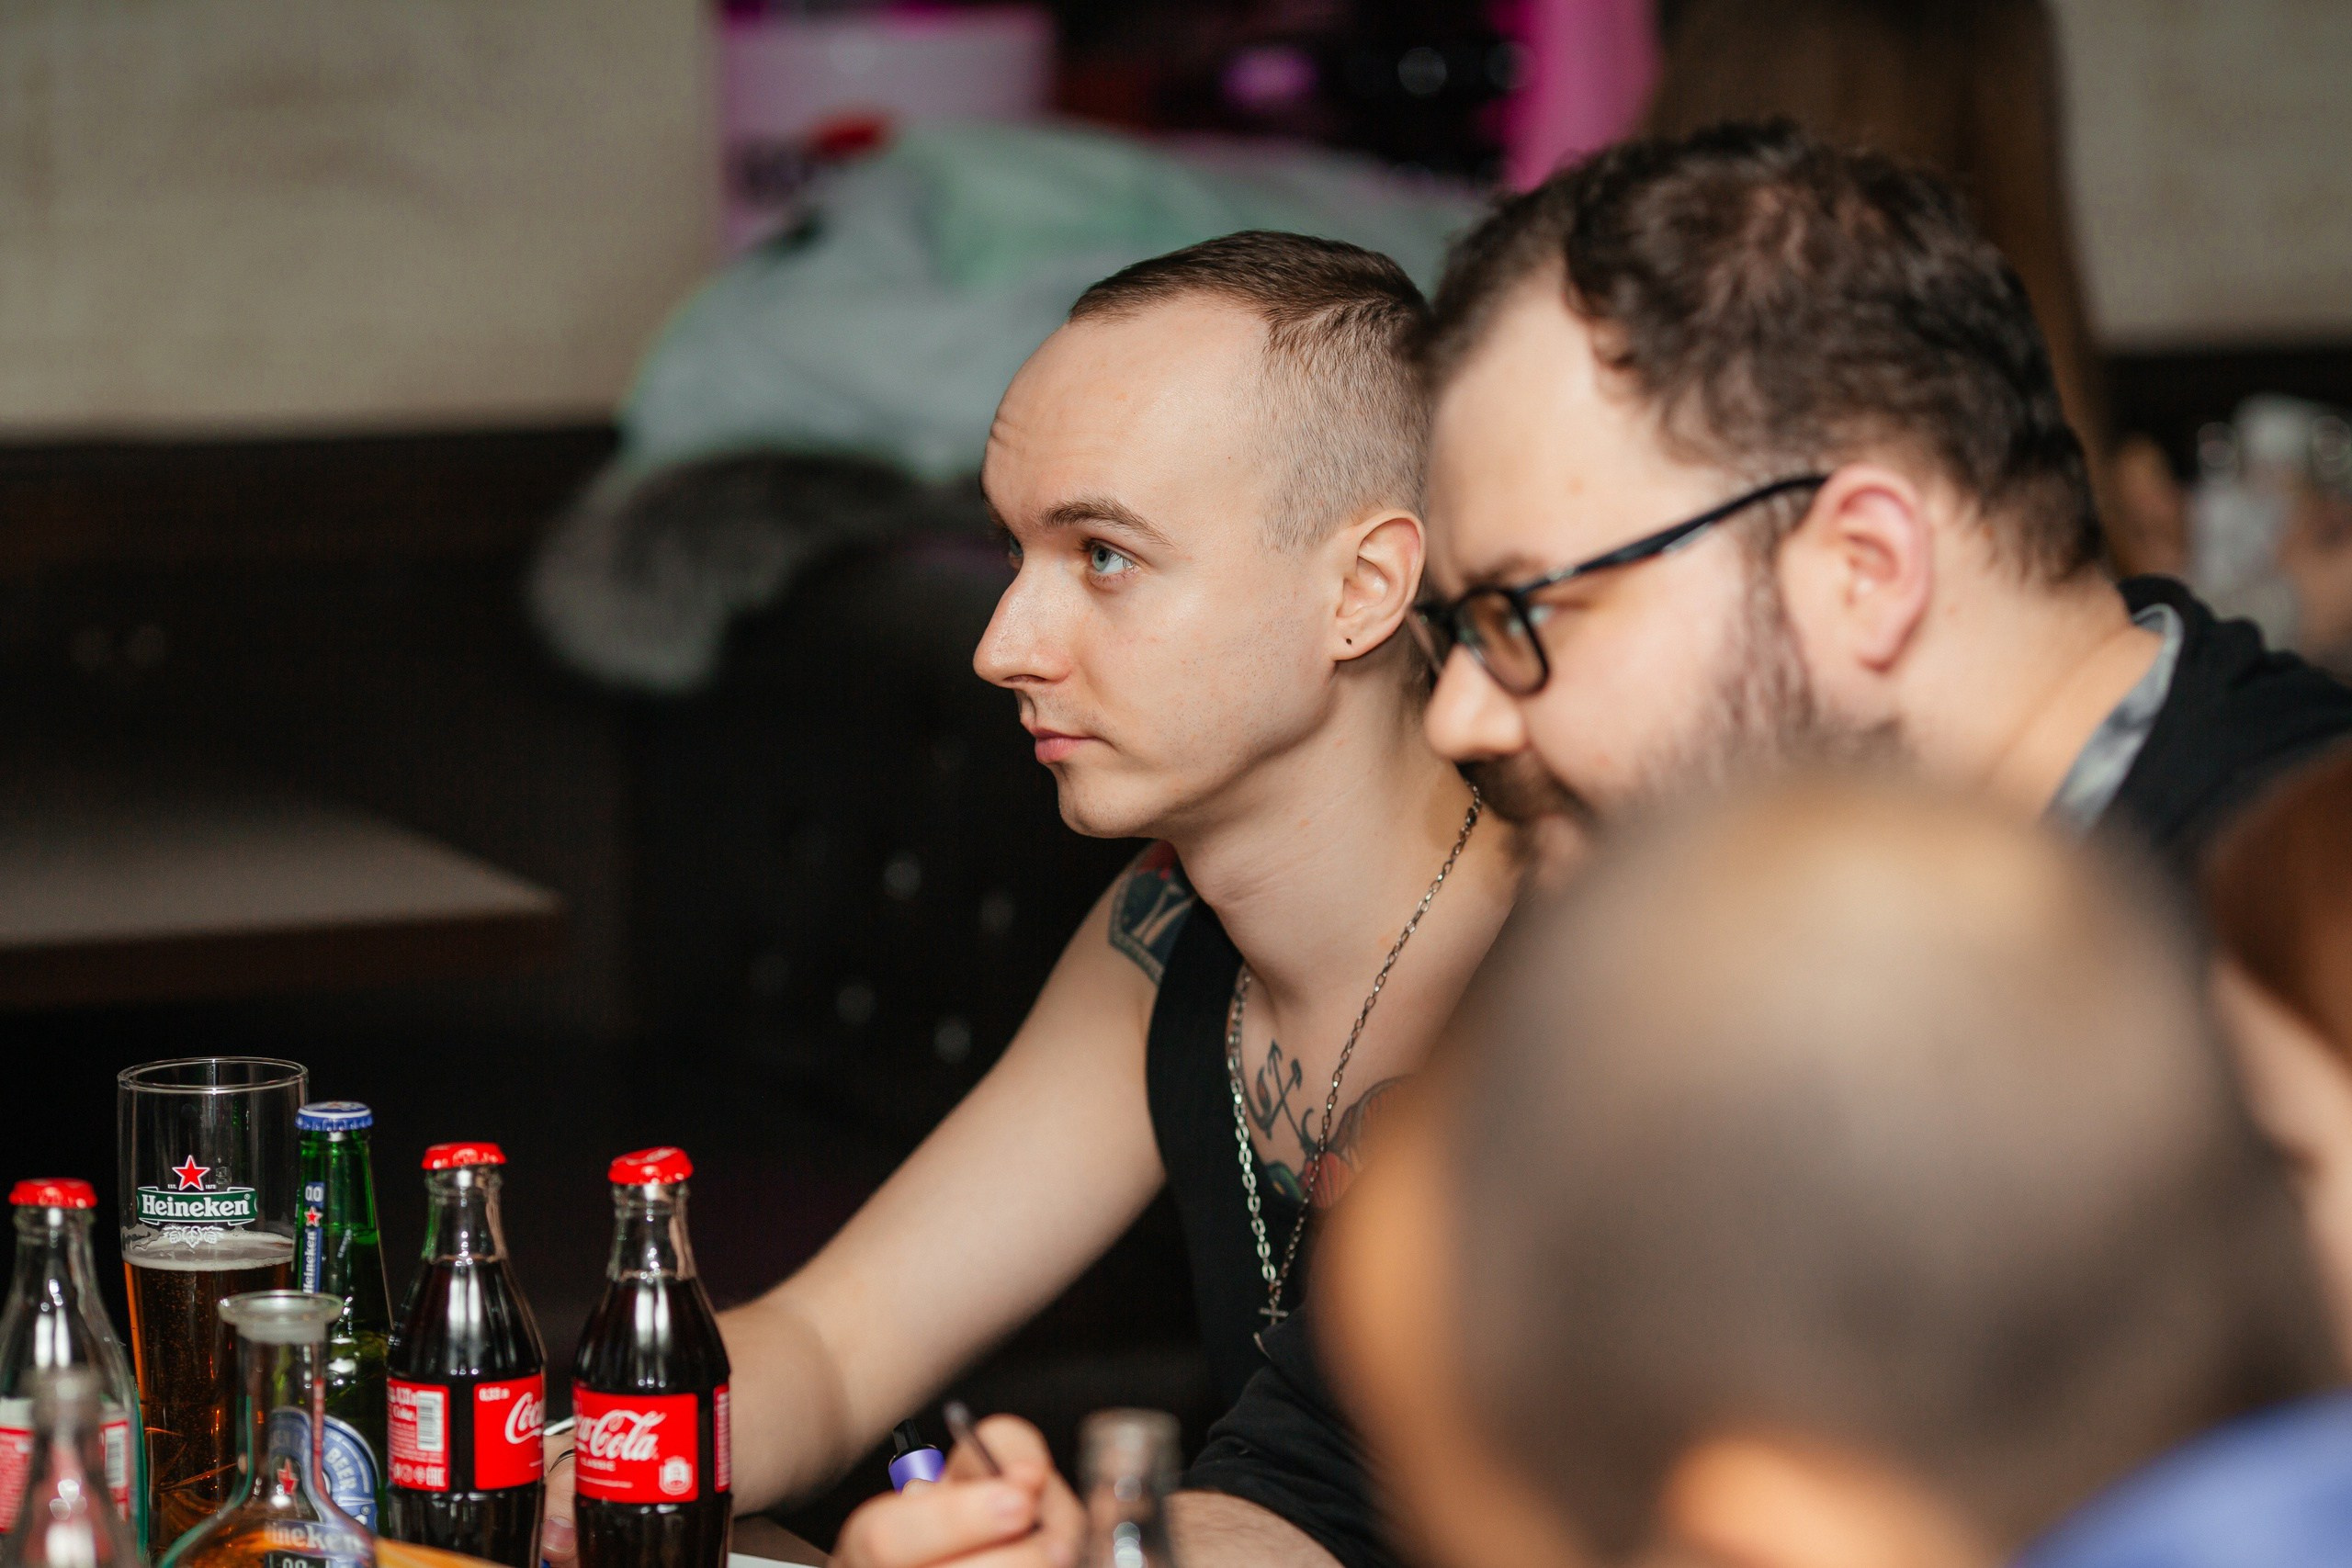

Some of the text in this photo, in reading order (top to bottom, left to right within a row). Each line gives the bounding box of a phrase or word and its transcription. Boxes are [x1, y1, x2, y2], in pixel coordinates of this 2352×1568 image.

[141, 1194, 251, 1218] Heineken
[302, 1230, 318, 1293] Heineken
[324, 1447, 357, 1491] BEER
